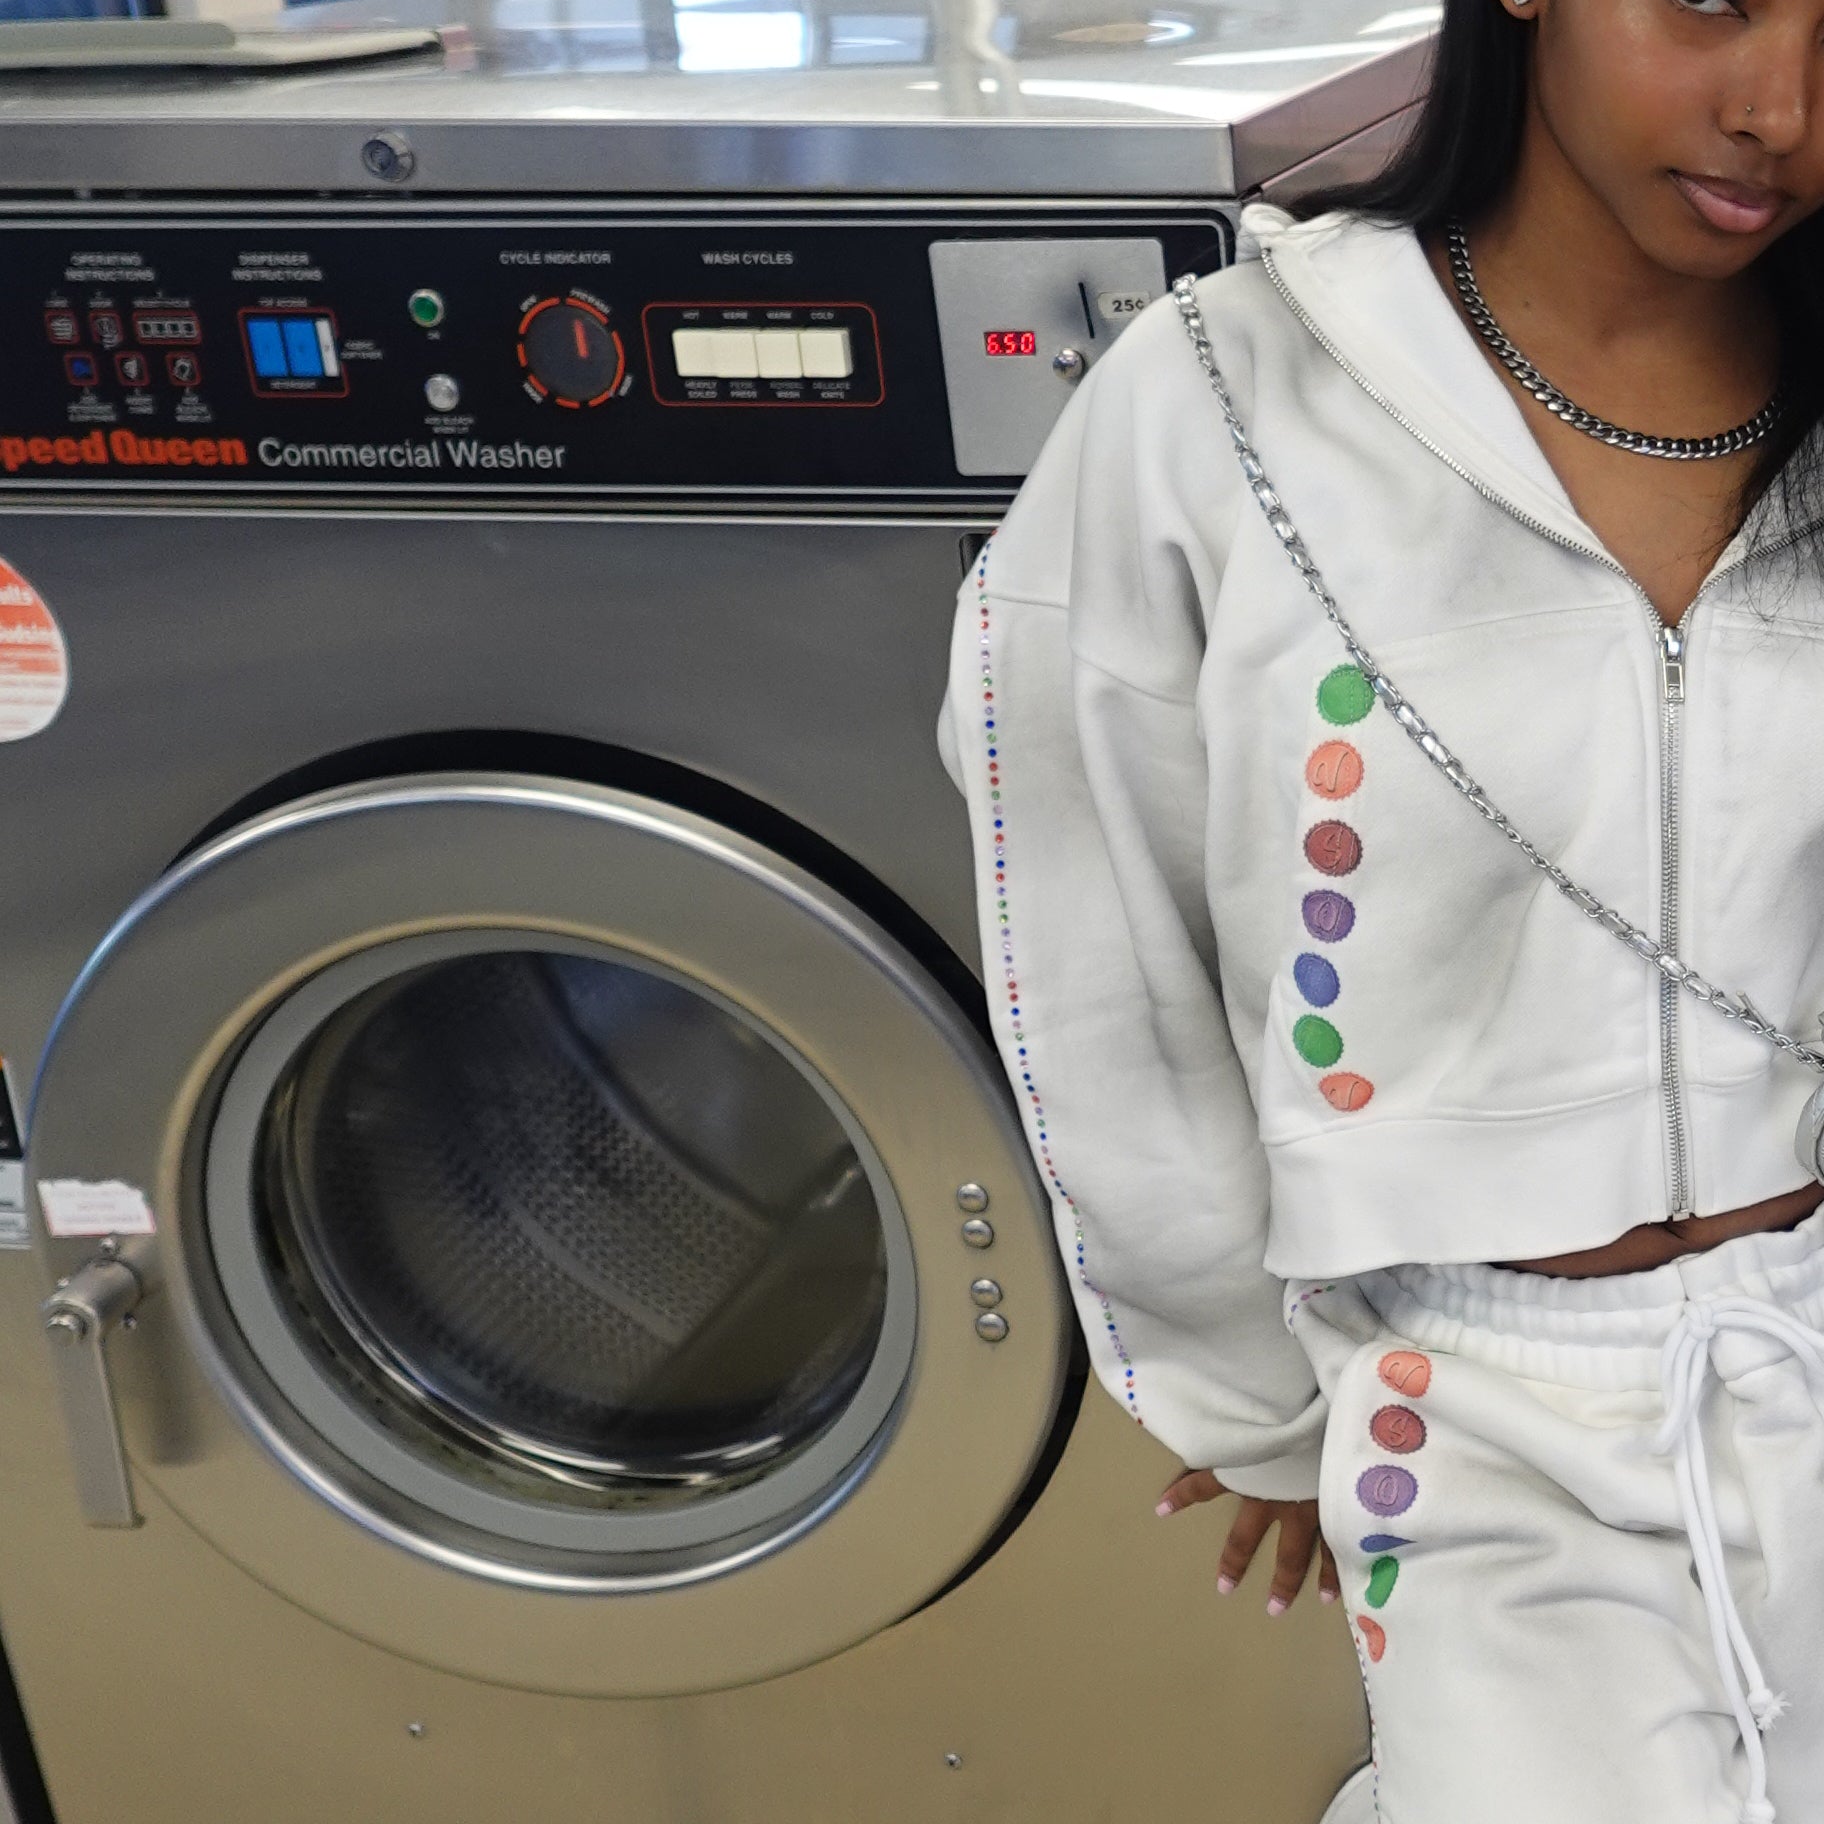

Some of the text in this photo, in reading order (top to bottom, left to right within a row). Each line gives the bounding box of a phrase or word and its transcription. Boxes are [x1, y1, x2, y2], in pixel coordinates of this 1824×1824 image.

[500, 251, 611, 265] CYCLE INDICATOR
[702, 251, 794, 265] WASH CYCLES
[986, 333, 1035, 354] 6.50
[0, 429, 565, 472] peed Queen Commercial Washer
